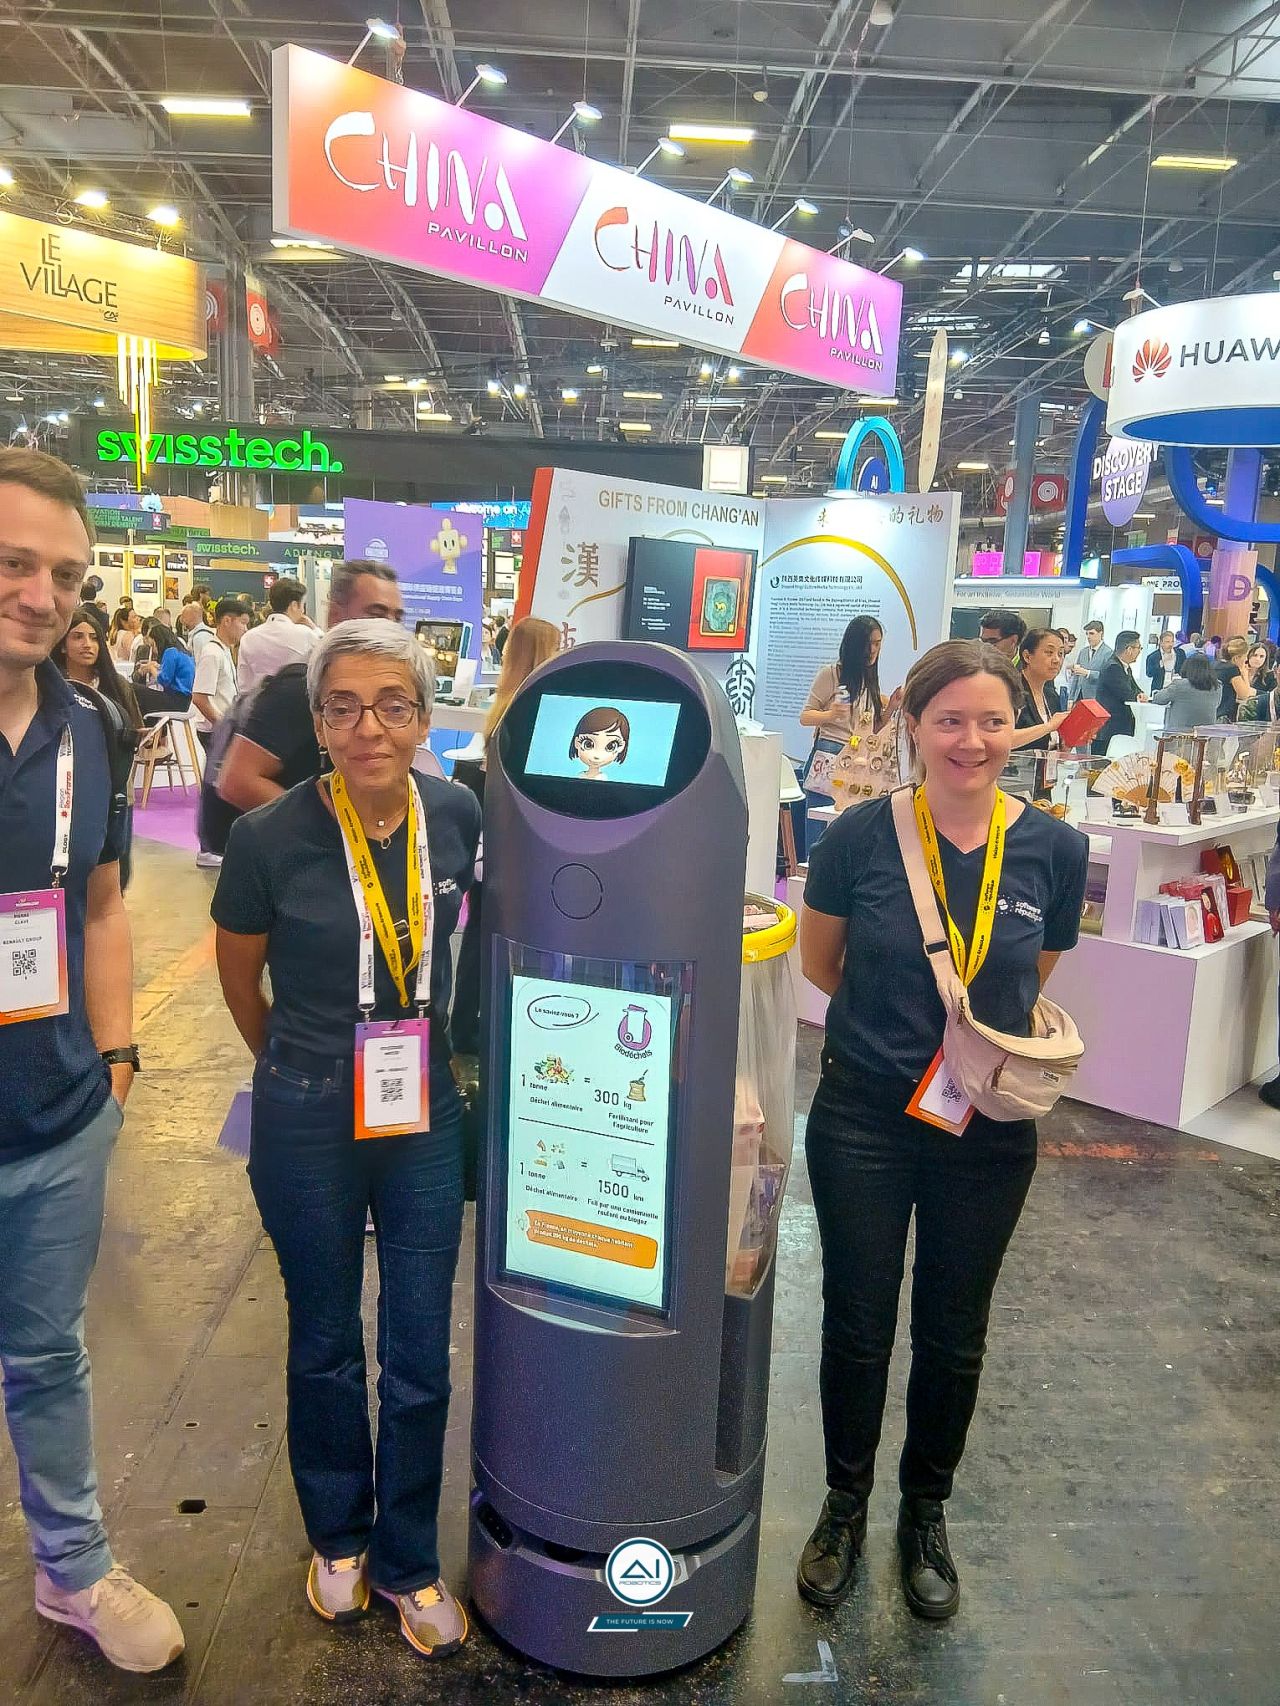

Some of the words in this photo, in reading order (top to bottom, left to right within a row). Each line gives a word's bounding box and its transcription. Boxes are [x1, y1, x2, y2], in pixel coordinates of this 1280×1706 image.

[324, 111, 528, 241] CHINA
[42, 234, 61, 266] LE
[428, 222, 528, 263] PAVILLON
[594, 206, 734, 306] CHINA
[20, 261, 118, 308] VILLAGE
[664, 296, 734, 325] PAVILLON
[780, 272, 883, 356] CHINA
[830, 347, 883, 371] PAVILLON
[1180, 338, 1280, 367] HUAW
[97, 428, 344, 473] swisstech.
[1093, 441, 1159, 480] DISCOVERY
[1104, 471, 1143, 502] STAGE
[599, 489, 643, 512] GIFTS
[647, 496, 687, 518] FROM
[691, 503, 759, 527] CHANG'AN
[196, 543, 260, 556] swisstech.
[521, 1074, 526, 1087] 1
[594, 1089, 619, 1106] 300
[623, 1101, 632, 1110] kg
[639, 1119, 654, 1127] pour
[520, 1162, 524, 1175] 1
[528, 1170, 546, 1179] tonne
[598, 1179, 629, 1198] 1500
[633, 1193, 644, 1202] km
